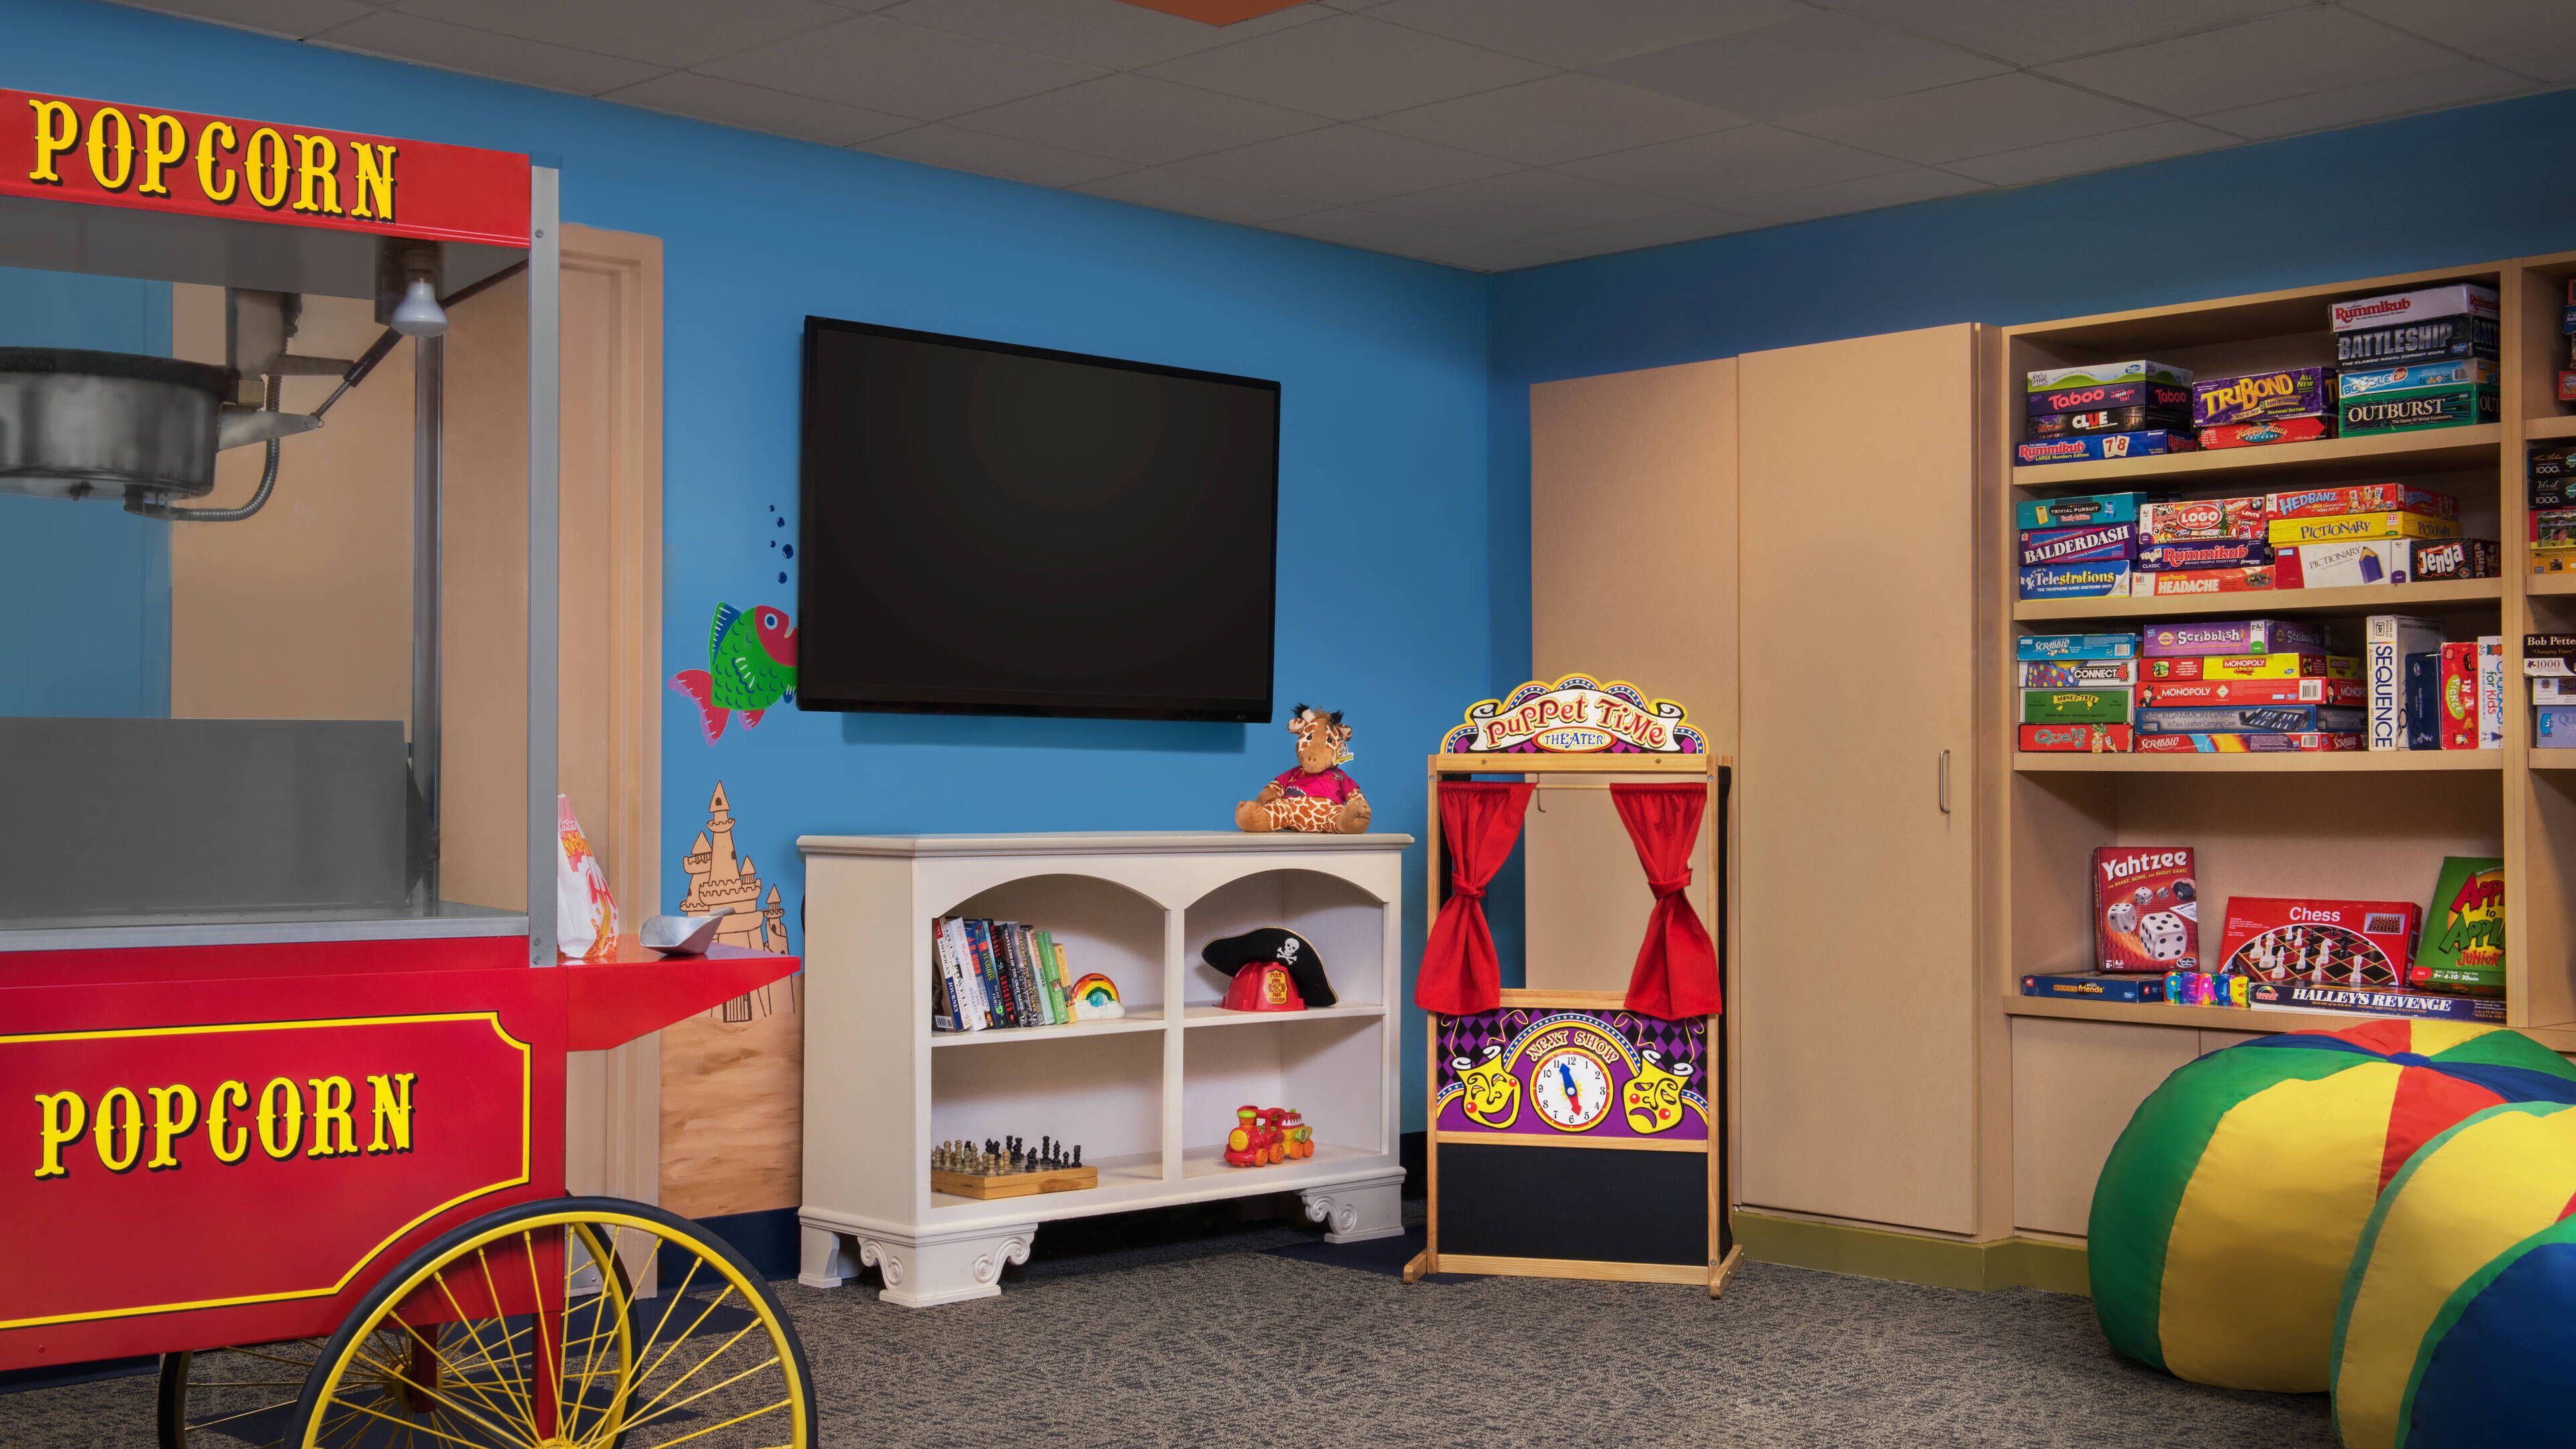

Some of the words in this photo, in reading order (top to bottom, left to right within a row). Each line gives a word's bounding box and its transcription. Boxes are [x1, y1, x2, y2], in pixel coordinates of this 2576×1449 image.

[28, 99, 397, 224] POPCORN
[2335, 297, 2411, 323] Rummikub
[2339, 323, 2453, 360] BATTLESHIP
[2048, 388, 2105, 411] Taboo
[2155, 388, 2187, 405] Taboo
[2259, 401, 2265, 410] 3
[2348, 398, 2447, 423] OUTBURST
[2072, 411, 2108, 429] CLUE
[2236, 426, 2265, 440] Happy
[2266, 423, 2288, 436] Hour
[2019, 441, 2086, 461] Rummikub
[2105, 439, 2114, 452] 7
[2117, 437, 2127, 451] 8
[2536, 466, 2559, 474] 1000
[2279, 492, 2339, 516] HEDBANZ
[2536, 496, 2558, 504] 1000
[2182, 512, 2218, 523] LOGO
[2299, 520, 2372, 539] PICTIONARY
[2024, 525, 2130, 564] BALDERDASH
[2163, 544, 2249, 568] Rummikub
[2310, 545, 2361, 570] PICTIONARY
[2419, 544, 2464, 574] Jenga
[2035, 572, 2114, 586] Telestrations
[2157, 579, 2219, 594] HEADACHE
[2178, 629, 2245, 645] Scribblish!
[2527, 637, 2547, 646] Bob
[2033, 639, 2070, 653] SCRABBLE
[2224, 659, 2265, 667] MONOPOLY
[2536, 659, 2561, 669] 1000
[2074, 669, 2117, 679] CONNECT
[2116, 663, 2127, 681] 4
[2487, 671, 2498, 686] for
[2161, 688, 2211, 697] MONOPOLY
[2461, 680, 2472, 693] IN
[2375, 645, 2393, 747] SEQUENCE
[2450, 678, 2464, 714] PICKLE
[2465, 697, 2475, 708] A
[2486, 690, 2498, 715] Kids
[2144, 711, 2209, 720] BACKGAMMON
[2202, 720, 2224, 730] Carrying
[1544, 731, 1604, 749] THEATER
[2035, 728, 2086, 748] Quelf
[2138, 737, 2180, 751] SCRABBLE
[2101, 851, 2188, 881] Yahtzee
[2290, 906, 2341, 922] Chess
[2485, 908, 2496, 918] to
[936, 926, 942, 936] MY
[967, 936, 974, 944] J.
[989, 925, 1001, 957] MICHAEL
[1003, 928, 1014, 960] TRAVELERS
[1010, 959, 1015, 967] OF
[1016, 929, 1026, 959] VOYAGERS
[969, 945, 977, 953] D.
[938, 940, 951, 975] AMERICAN
[2456, 949, 2502, 967] JUNIOR
[983, 951, 994, 981] HARRIS
[954, 964, 967, 1008] POWELL
[998, 975, 1014, 1012] CRICHTON
[2078, 985, 2104, 994] friends
[948, 981, 959, 1014] JOURNEY
[2292, 988, 2370, 1006] HALLEY'S
[2371, 994, 2453, 1012] REVENGE
[1526, 1030, 1569, 1062] NEXT
[1574, 1030, 1620, 1064] SHOW
[1554, 1060, 1560, 1068] 11
[1568, 1057, 1576, 1065] 12
[1585, 1061, 1589, 1069] 1
[1544, 1069, 1552, 1078] 10
[1595, 1071, 1601, 1079] 2
[1538, 1084, 1544, 1093] 9
[1599, 1087, 1605, 1095] 3
[1542, 1099, 1548, 1108] 8
[1594, 1102, 1600, 1110] 4
[1554, 1110, 1558, 1119] 7
[1568, 1115, 1574, 1124] 6
[1584, 1111, 1590, 1120] 5
[34, 1072, 418, 1180] POPCORN
